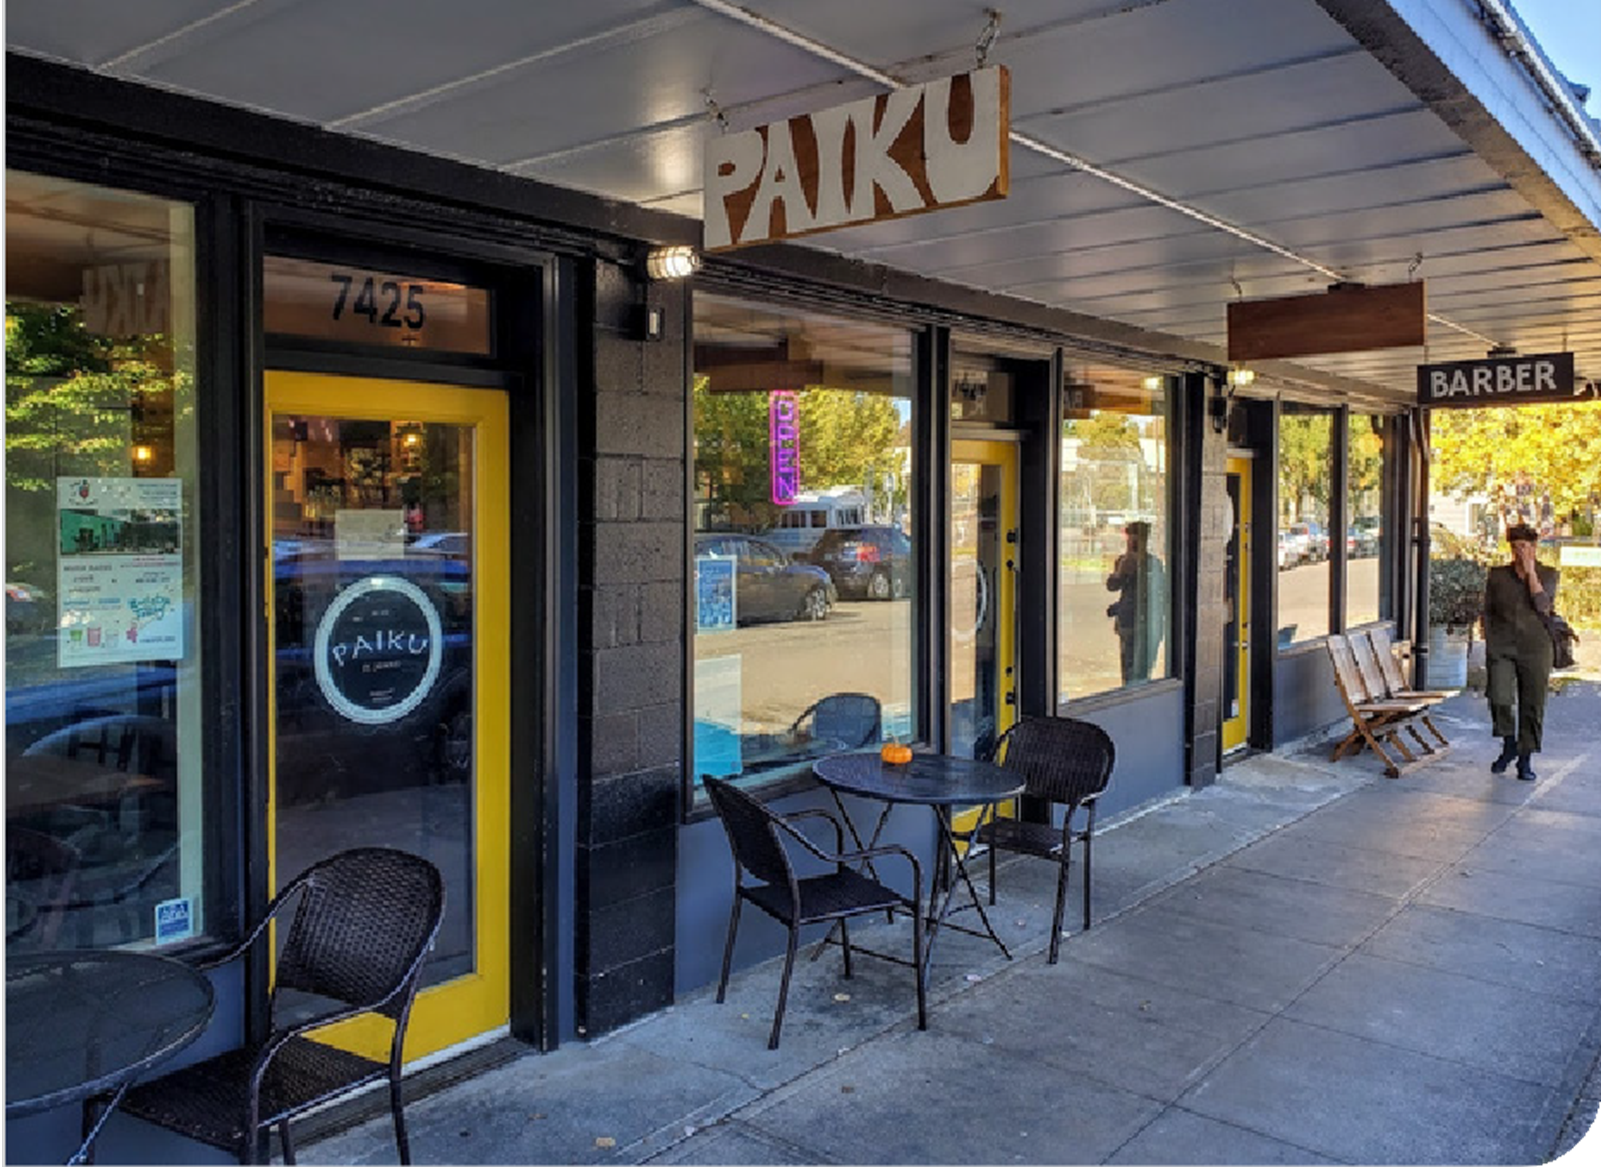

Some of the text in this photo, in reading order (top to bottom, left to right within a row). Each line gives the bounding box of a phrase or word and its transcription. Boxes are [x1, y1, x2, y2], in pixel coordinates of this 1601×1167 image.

[704, 66, 1000, 249] PAIKU
[331, 273, 425, 330] 7425
[1430, 360, 1557, 398] BARBER
[777, 400, 795, 499] OPEN
[332, 629, 428, 667] PAIKU
